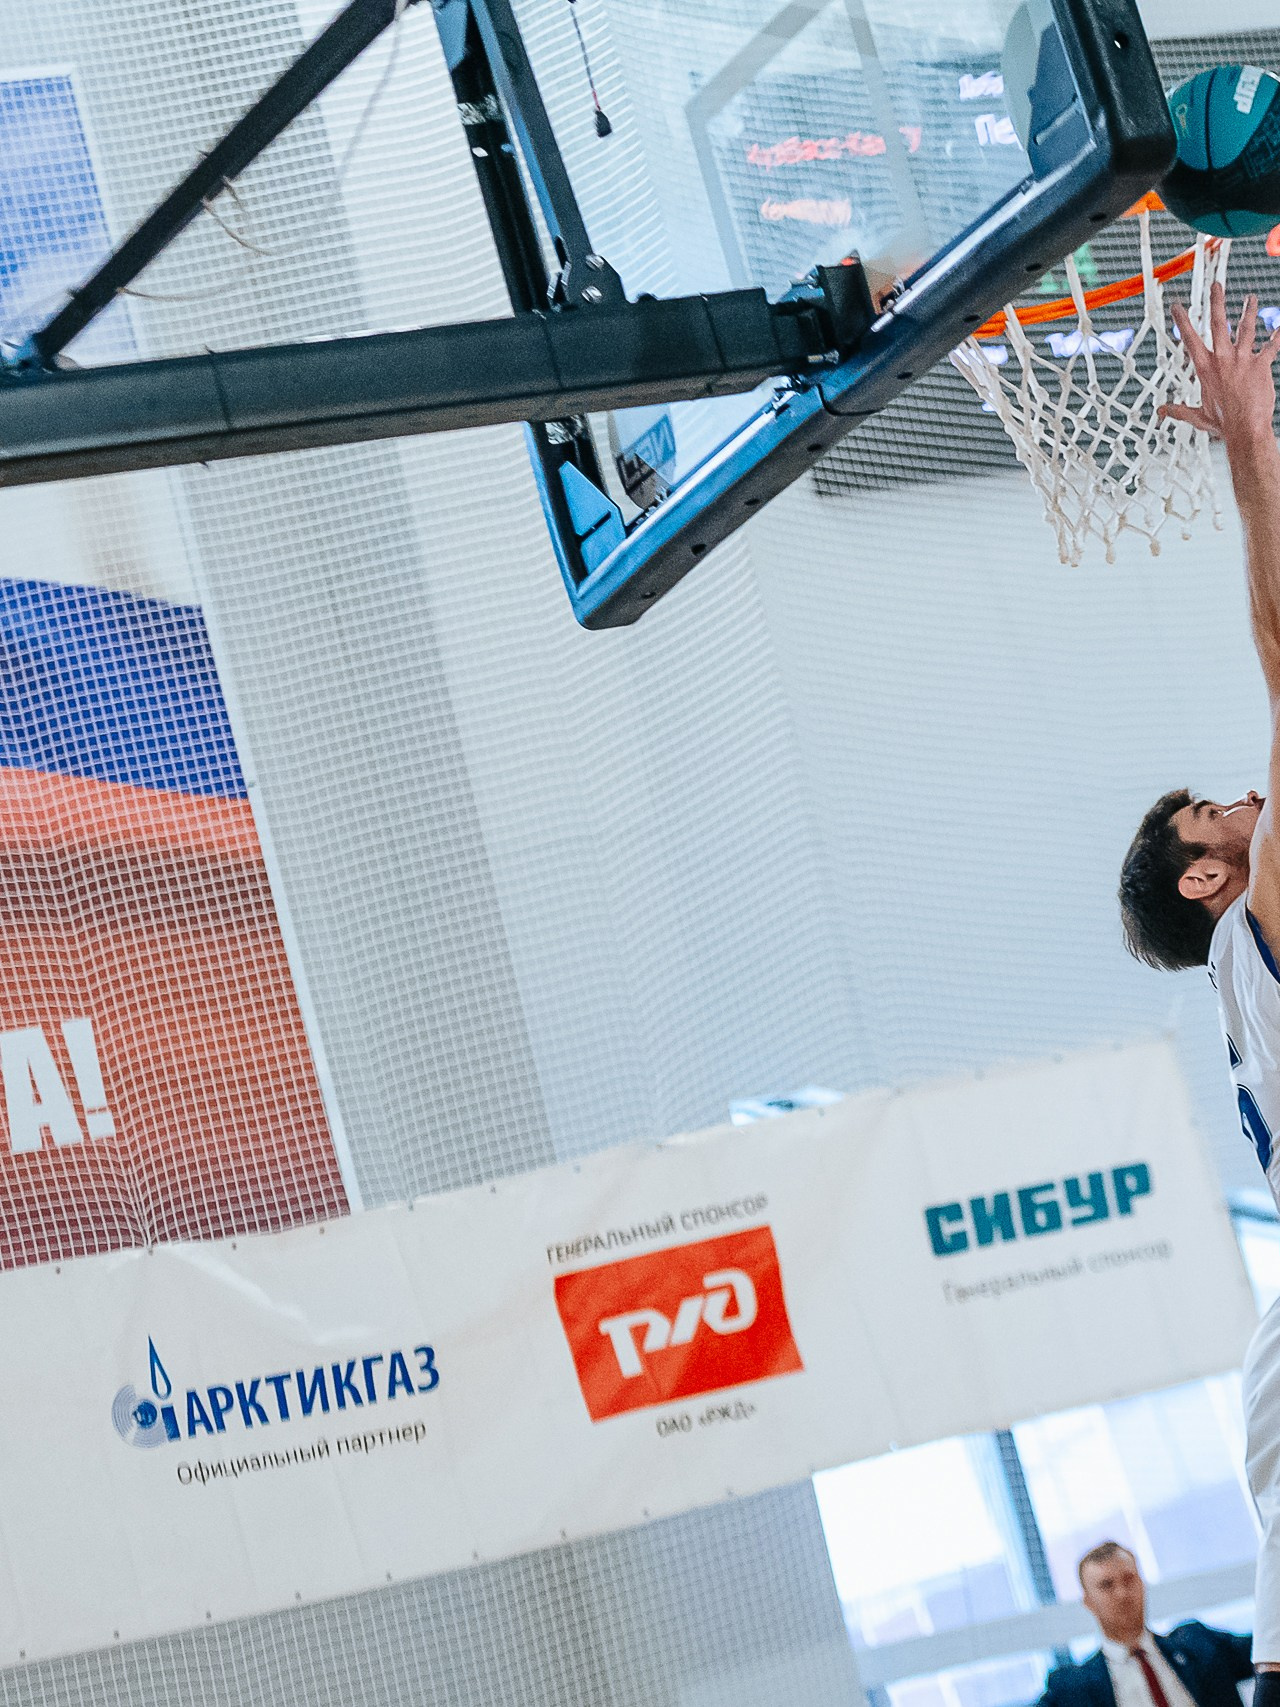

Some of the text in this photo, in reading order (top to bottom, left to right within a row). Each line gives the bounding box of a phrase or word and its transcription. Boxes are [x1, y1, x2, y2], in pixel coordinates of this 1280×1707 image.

[546, 1195, 768, 1265] ГЕНЕРАЛЬНЫЙ СПОНСОР
[925, 1163, 1151, 1256] СИБУР
[186, 1345, 440, 1438] АРКТИКГАЗ
[656, 1408, 693, 1438] ОАО
[176, 1420, 427, 1487] Официальный партнер
